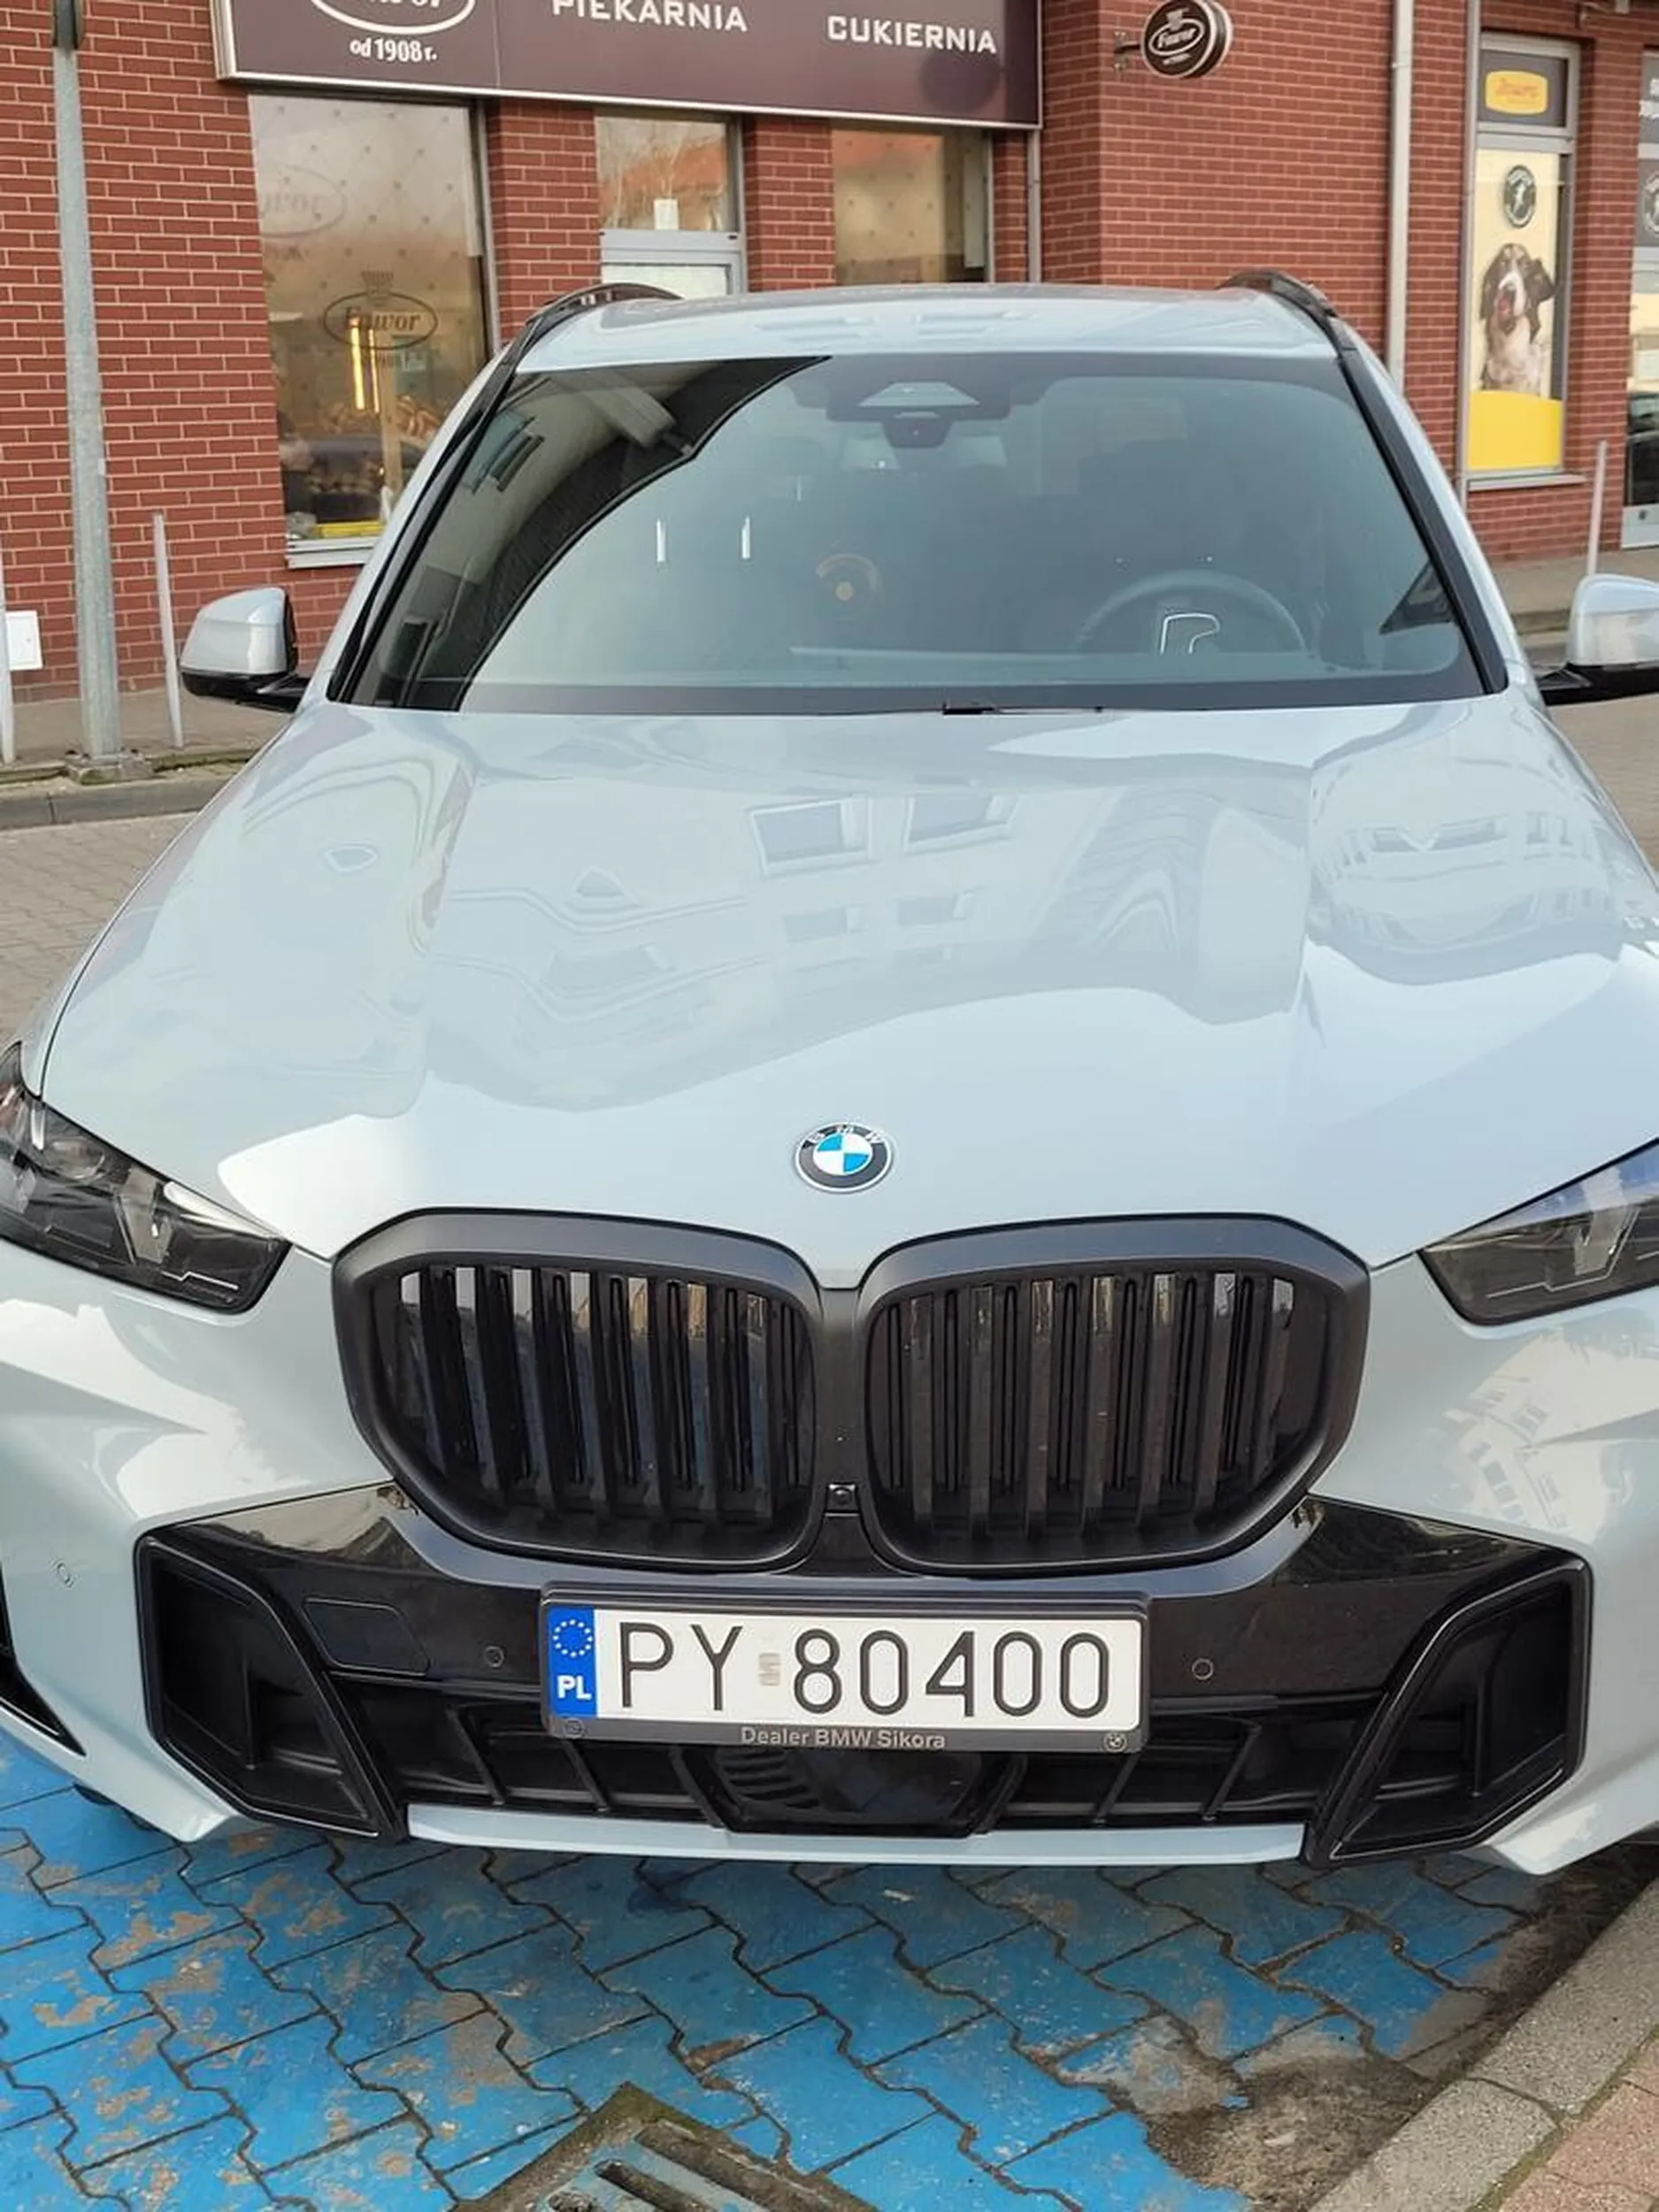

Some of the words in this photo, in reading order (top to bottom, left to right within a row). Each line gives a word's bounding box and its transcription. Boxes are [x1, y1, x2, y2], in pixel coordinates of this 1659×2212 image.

[552, 0, 748, 33] PIEKARNIA
[349, 37, 372, 58] od
[374, 38, 422, 62] 1908
[424, 47, 437, 61] r.
[827, 15, 997, 54] CUKIERNIA
[619, 1621, 743, 1711] PY
[794, 1628, 1110, 1718] 80400
[557, 1674, 592, 1701] PL
[741, 1726, 809, 1747] Dealer
[815, 1728, 871, 1747] BMW
[877, 1730, 946, 1750] Sikora
